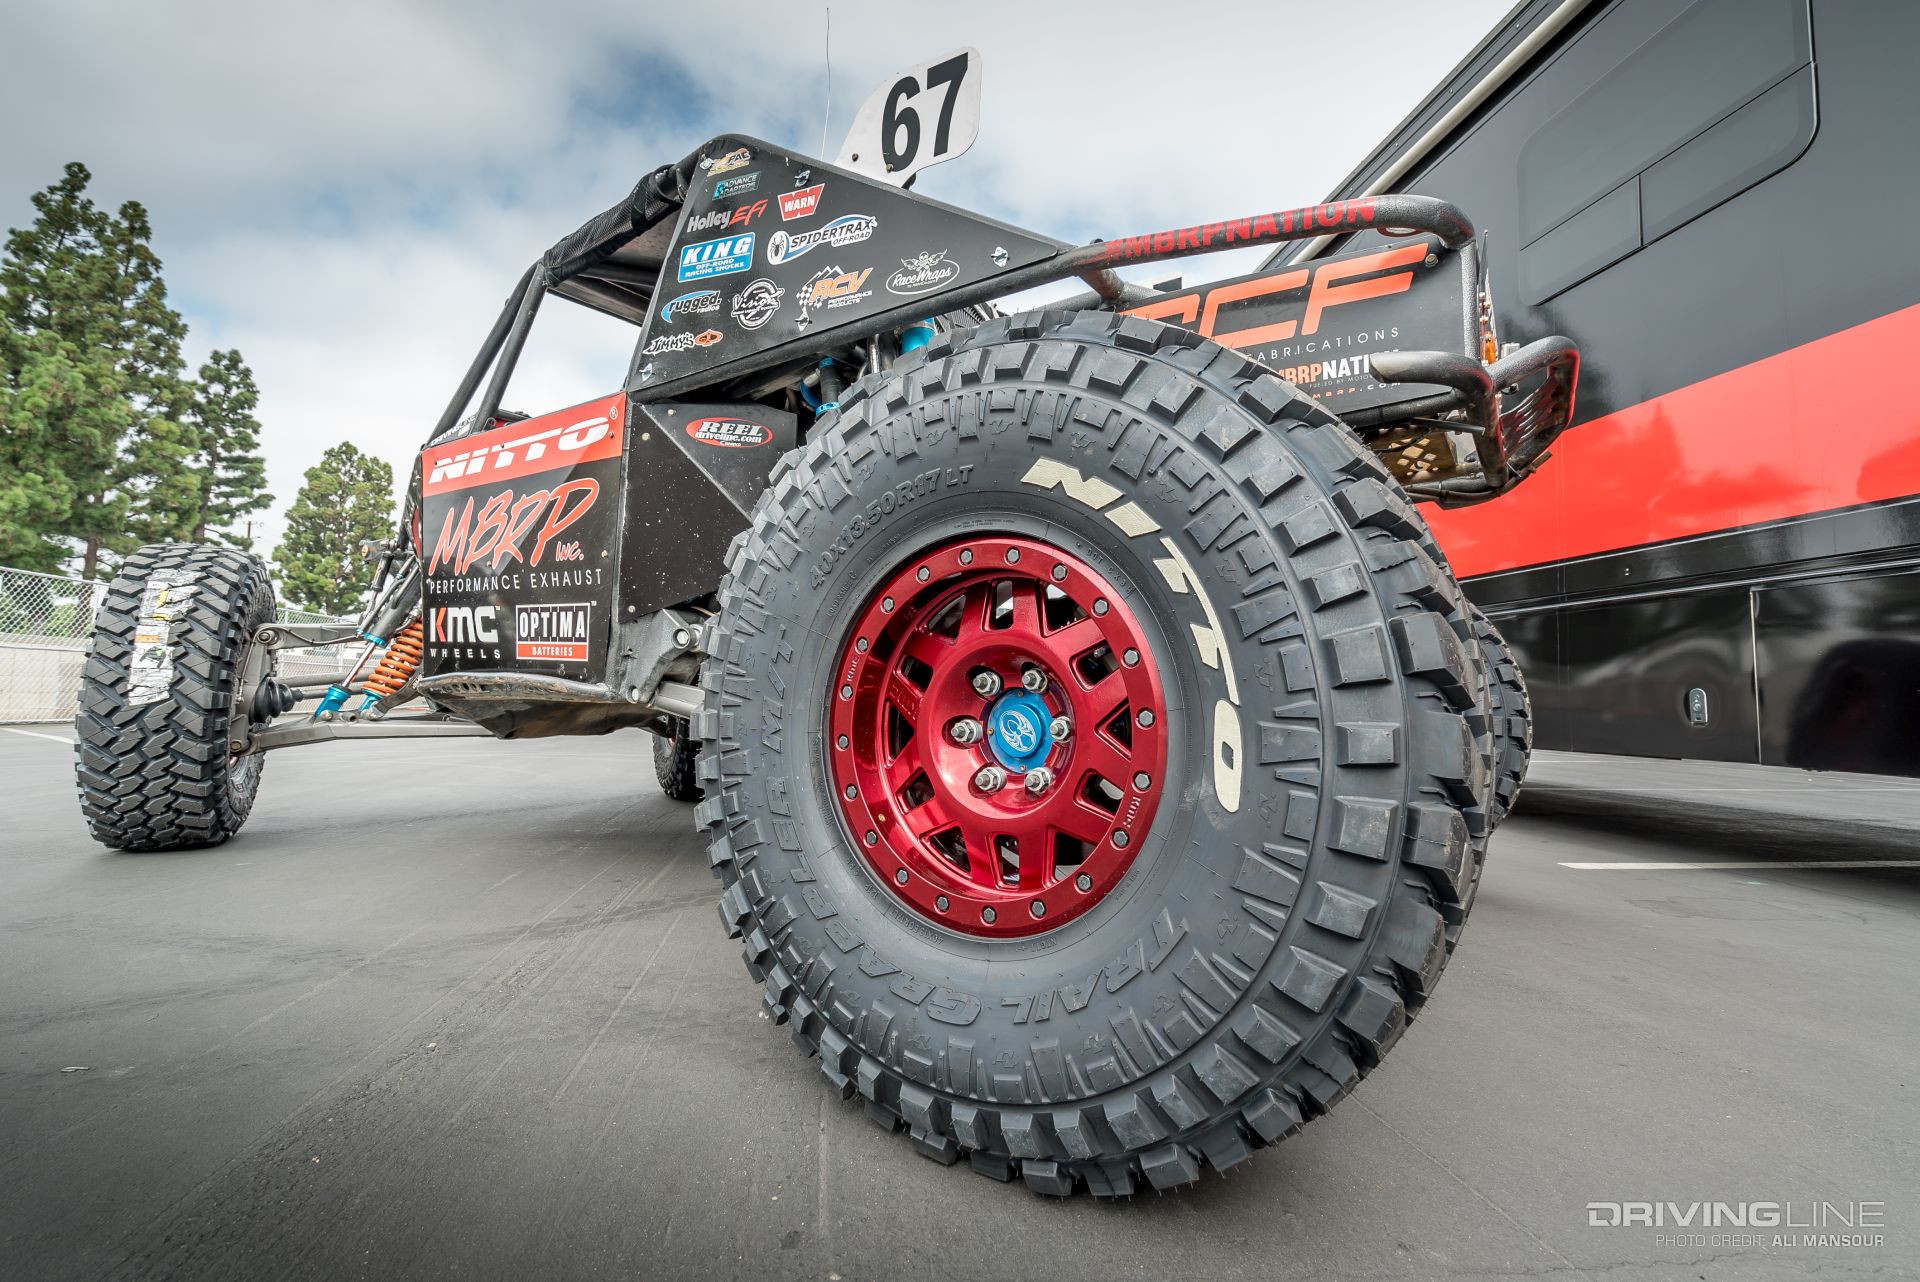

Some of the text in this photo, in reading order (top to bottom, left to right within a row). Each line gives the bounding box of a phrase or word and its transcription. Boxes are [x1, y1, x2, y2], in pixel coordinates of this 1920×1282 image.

[881, 51, 969, 172] 67
[724, 174, 758, 188] ADVANCE
[784, 194, 816, 213] WARN
[686, 210, 733, 233] Holley
[790, 219, 872, 249] SPIDERTRAX
[832, 230, 871, 246] OFF-ROAD
[682, 236, 753, 265] KING
[685, 261, 745, 278] RACING SHOCKS
[695, 258, 735, 270] OFF-ROAD
[808, 266, 874, 304] RCV
[891, 266, 952, 287] RaceWraps
[827, 290, 873, 305] PERFORMANCE
[827, 299, 861, 310] PRODUCTS
[696, 304, 720, 314] radios
[1246, 327, 1399, 362] ABRICATIONS
[694, 431, 762, 443] driveline.com
[698, 421, 763, 437] REEL
[428, 416, 610, 485] NITTO
[428, 477, 600, 577] MBRP
[430, 568, 602, 595] PERFORMANCE EXHAUST
[519, 610, 586, 638] OPTIMA
[1019, 457, 1243, 814] NITTO
[429, 648, 501, 659] WHEELS
[532, 646, 573, 657] BATTERIES
[766, 778, 983, 1027] GRAPPLER
[1001, 906, 1190, 1025] TRAIL
